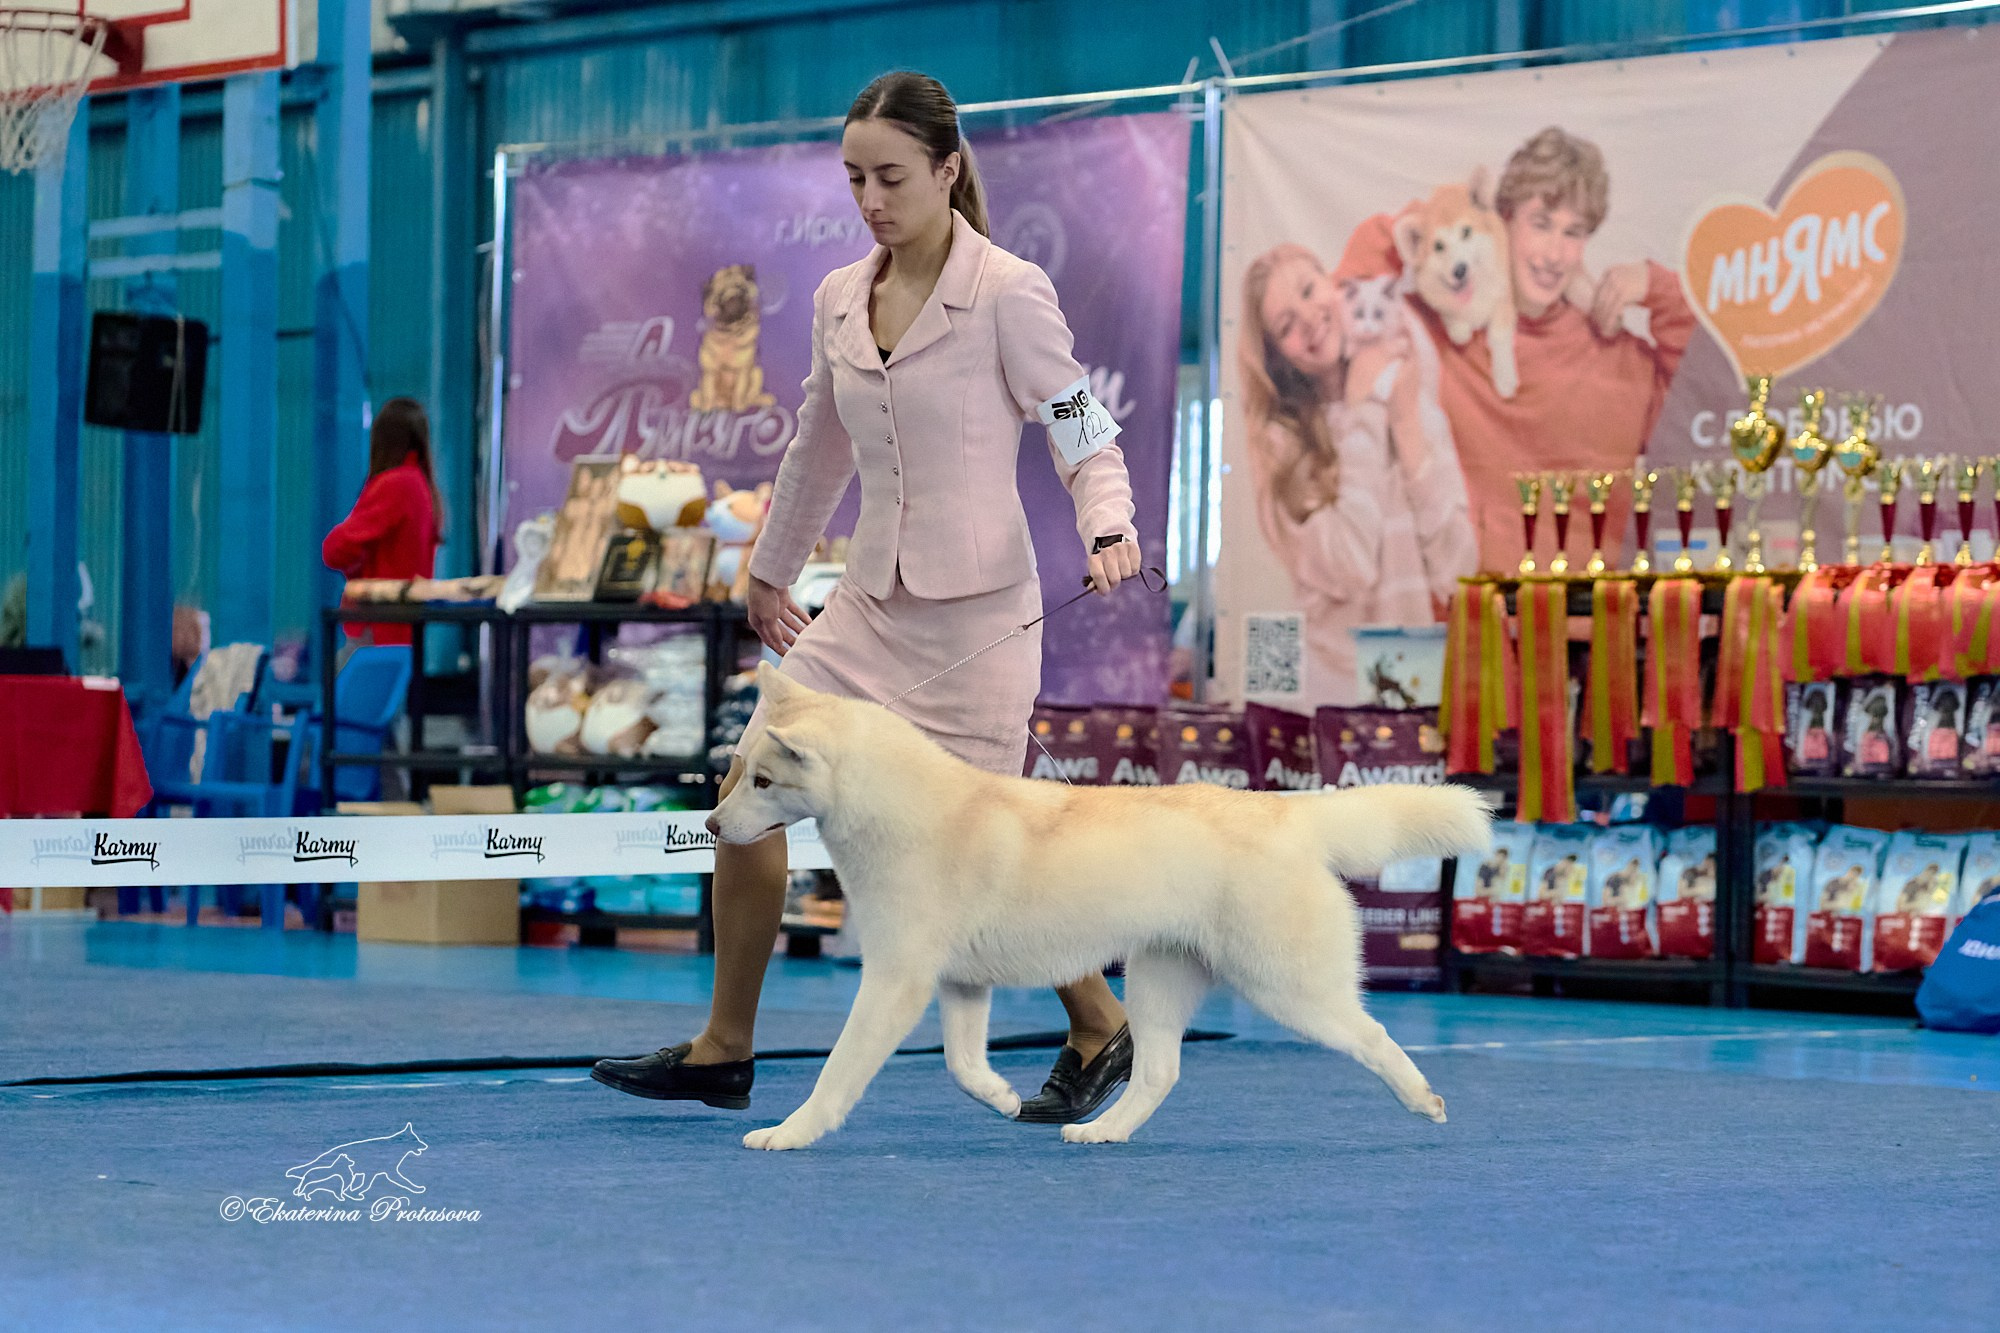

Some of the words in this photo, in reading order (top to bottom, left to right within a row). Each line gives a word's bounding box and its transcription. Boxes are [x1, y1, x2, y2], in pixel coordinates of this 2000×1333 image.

[1707, 202, 1890, 314] МНЯМС
[1690, 410, 1717, 448] С
[1722, 403, 1923, 445] ЛБОВЬЮ
[1337, 758, 1445, 786] Award
[91, 832, 160, 872] Karmy
[293, 831, 359, 868] Karmy
[484, 828, 545, 864] Karmy
